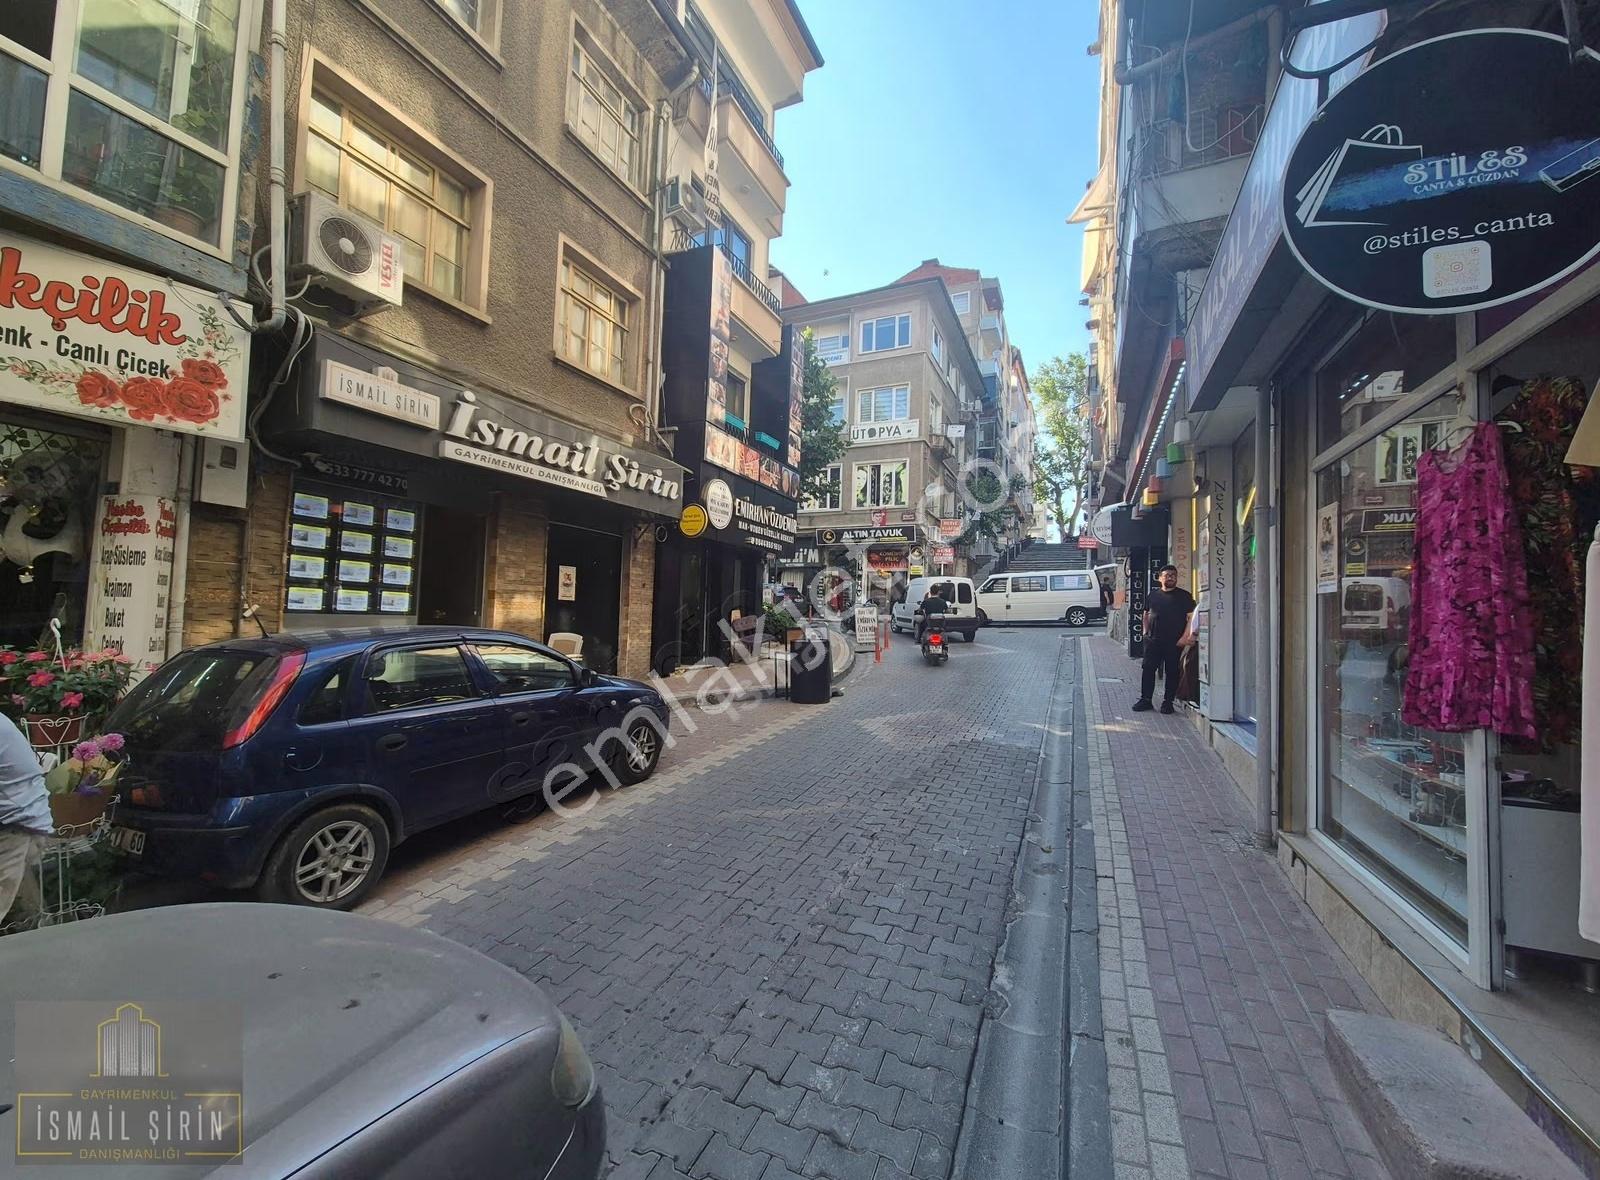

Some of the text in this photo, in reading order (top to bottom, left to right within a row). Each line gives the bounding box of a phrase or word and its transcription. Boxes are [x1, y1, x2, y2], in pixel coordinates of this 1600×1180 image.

[1363, 211, 1556, 255] @stiles_canta
[56, 334, 110, 367] Canlı
[339, 372, 388, 406] İSMAİL
[445, 390, 680, 500] İsmail Şirin
[352, 468, 375, 482] 777
[378, 475, 393, 487] 42
[394, 477, 408, 489] 70
[842, 530, 869, 539] ALTIN
[869, 528, 903, 538] TAVUK
[113, 544, 147, 567] Süsleme
[104, 606, 125, 629] Buket
[1132, 570, 1144, 643] TÜTÜNCÜ
